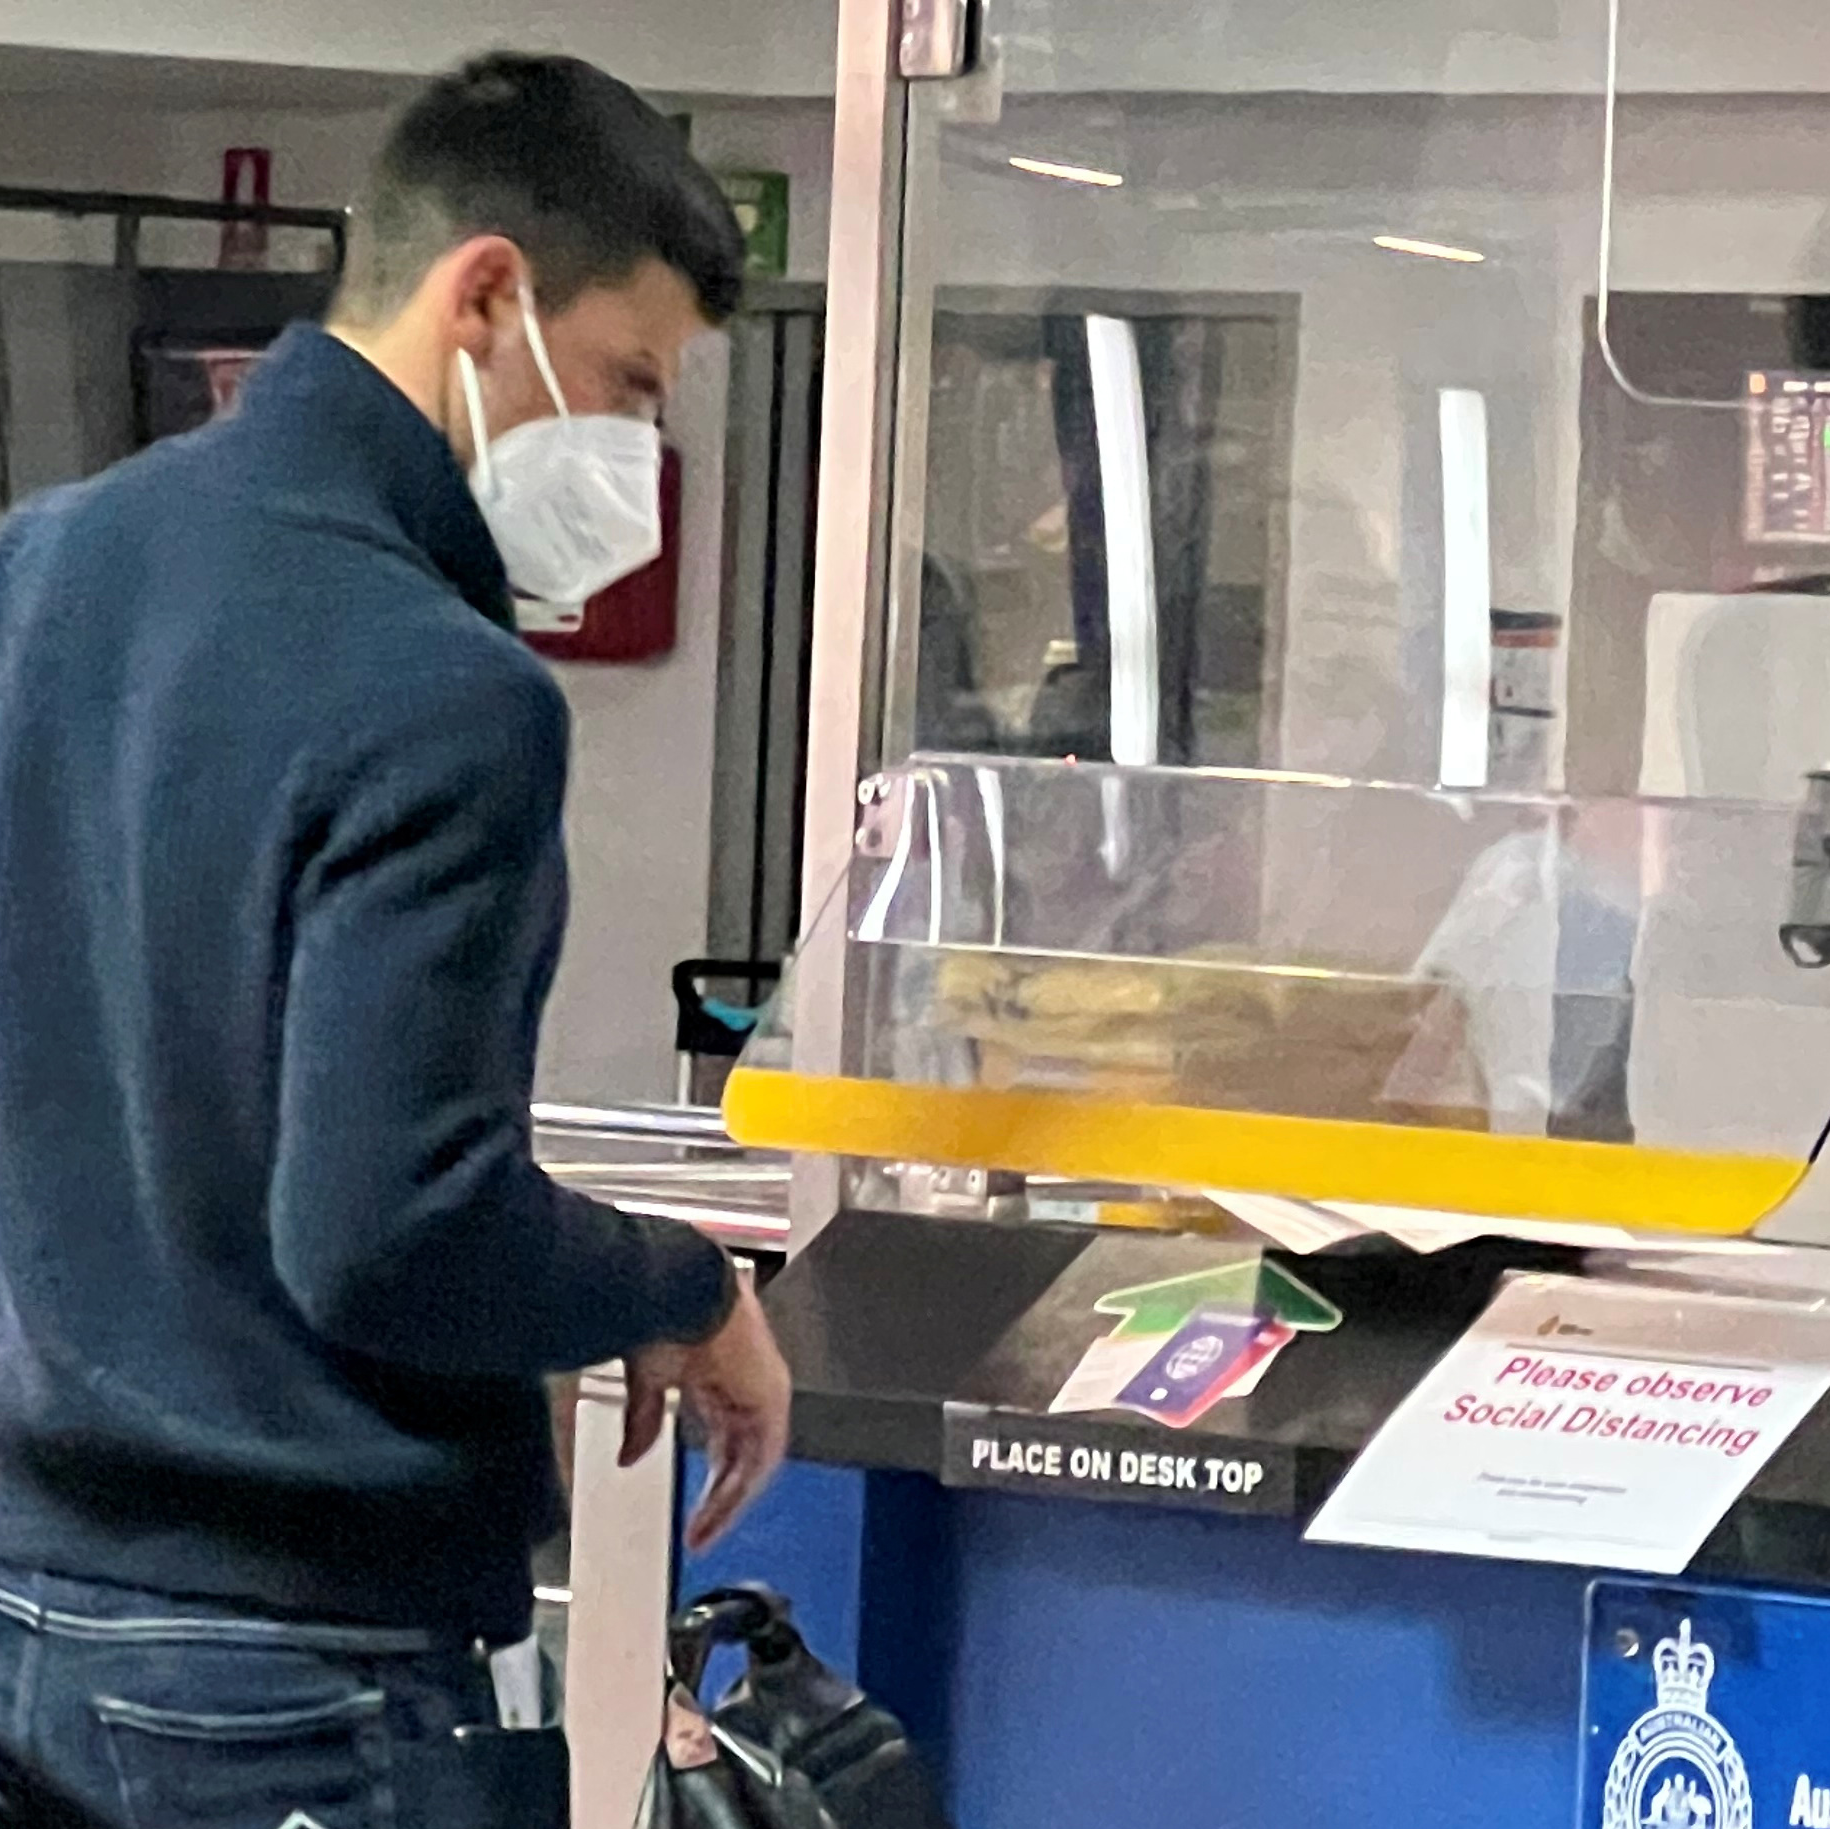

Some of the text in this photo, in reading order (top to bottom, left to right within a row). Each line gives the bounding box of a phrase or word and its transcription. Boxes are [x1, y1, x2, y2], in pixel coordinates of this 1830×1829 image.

[1495, 1356, 1773, 1408] Please observe
[1443, 1395, 1760, 1457] Social Distancing
[972, 1439, 1263, 1494] PLACE ON DESK TOP
